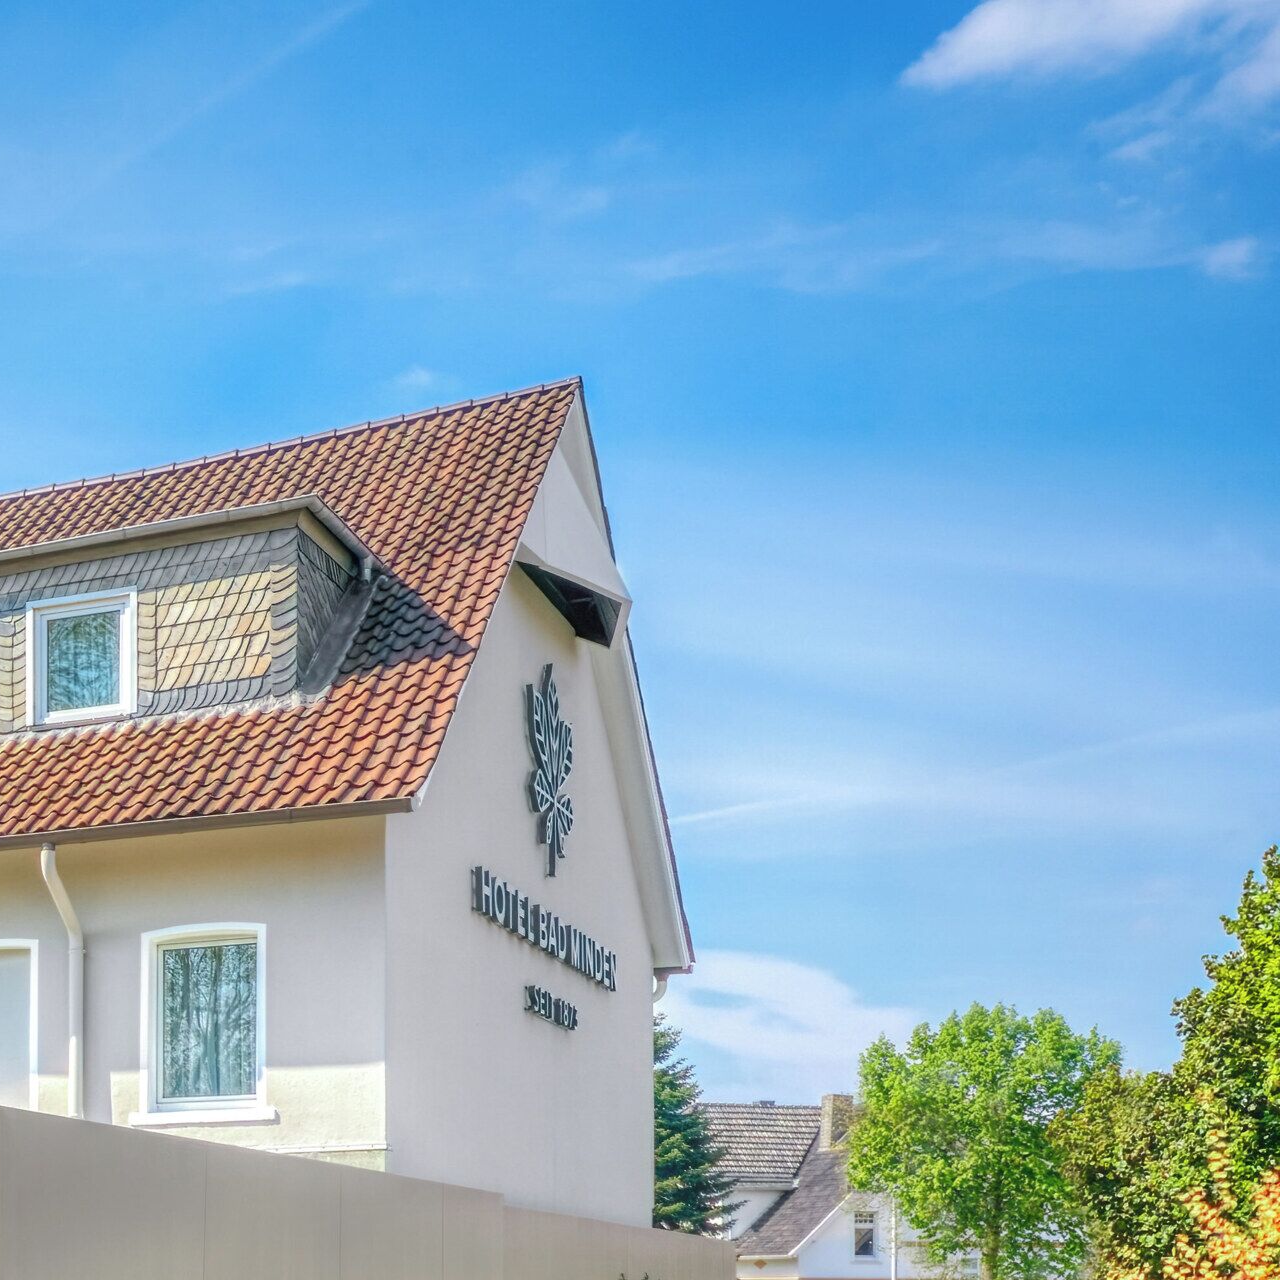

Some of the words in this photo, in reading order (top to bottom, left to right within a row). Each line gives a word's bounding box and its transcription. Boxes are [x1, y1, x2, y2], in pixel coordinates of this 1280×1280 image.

[471, 865, 537, 944] HOTEL
[538, 904, 568, 961] BAD
[569, 924, 617, 992] MINDEN
[524, 985, 555, 1020] SEIT
